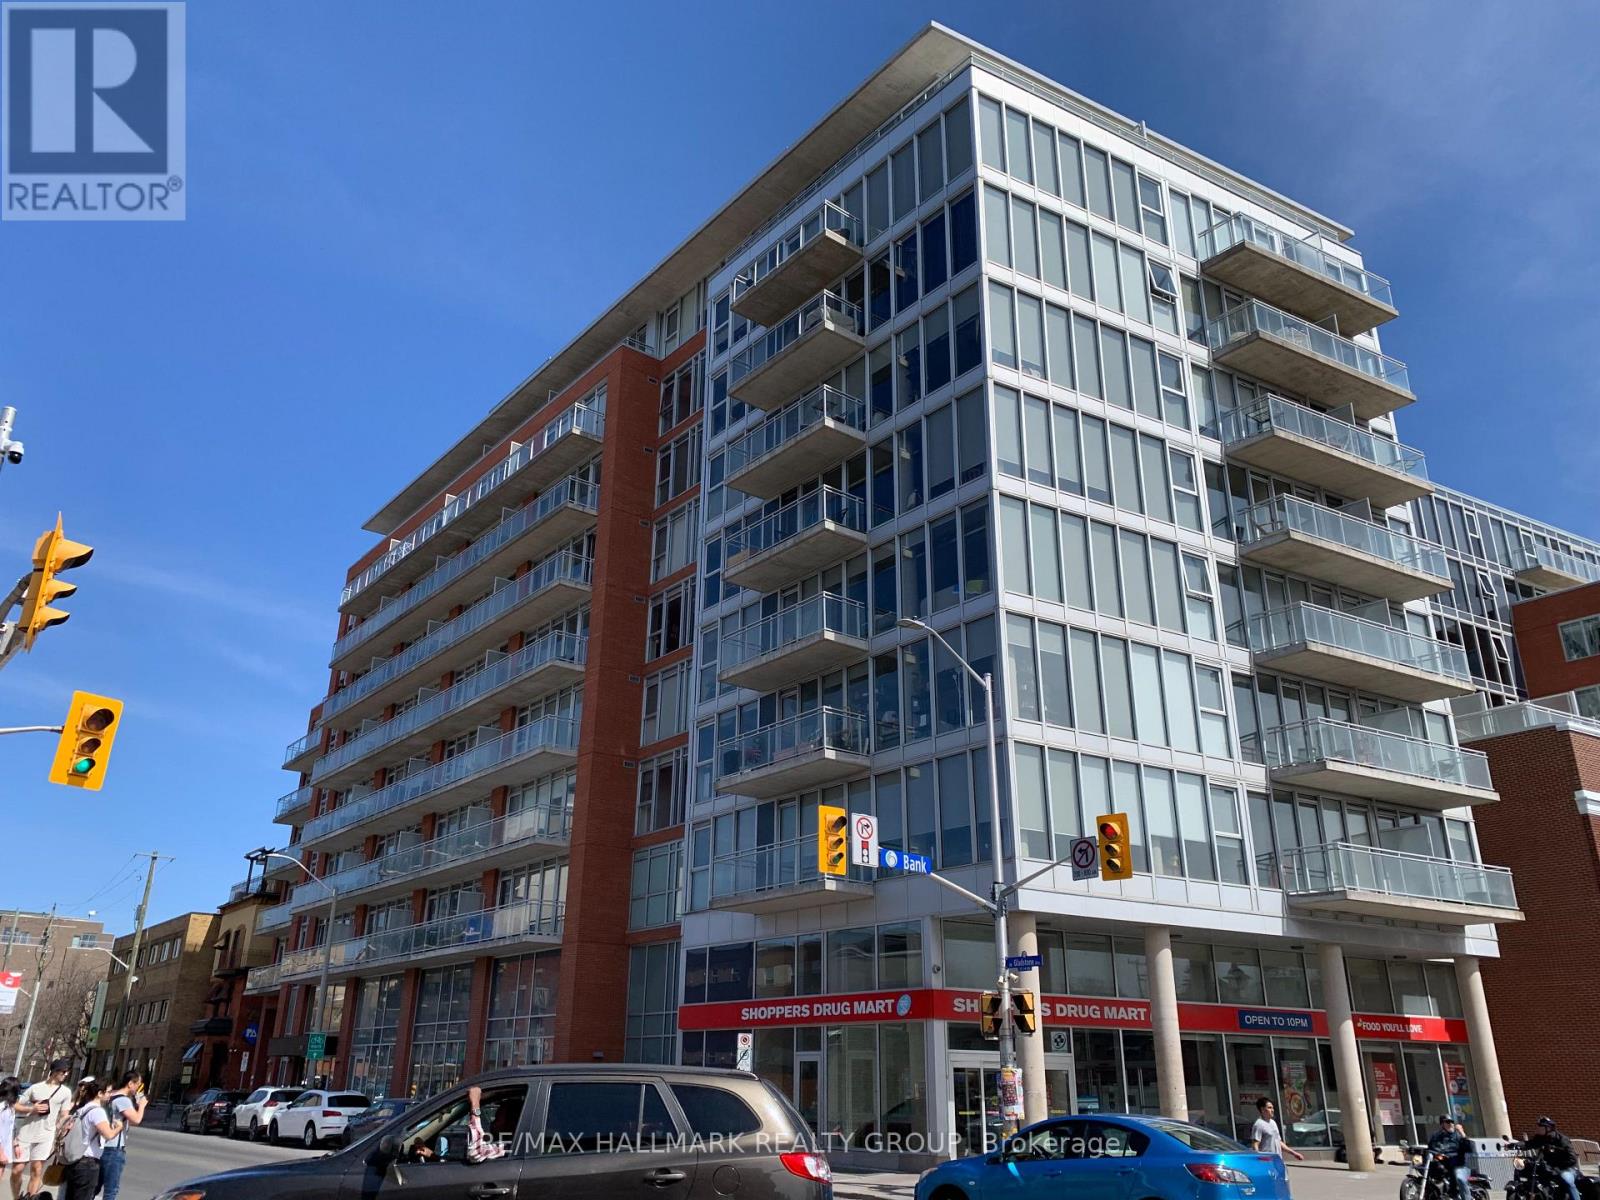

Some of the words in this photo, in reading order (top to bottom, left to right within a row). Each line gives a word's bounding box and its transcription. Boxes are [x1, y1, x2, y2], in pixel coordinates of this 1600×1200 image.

[903, 854, 927, 873] Bank
[741, 1003, 810, 1021] SHOPPERS
[813, 1001, 850, 1017] DRUG
[853, 999, 895, 1015] MART
[1055, 1004, 1101, 1019] DRUG
[1104, 1005, 1147, 1021] MART
[1244, 1015, 1271, 1025] OPEN
[1272, 1016, 1285, 1026] TO
[1287, 1017, 1309, 1027] 10PM
[1362, 1021, 1381, 1031] FOOD
[1381, 1022, 1405, 1032] YOU'LL
[1406, 1023, 1424, 1033] LOVE
